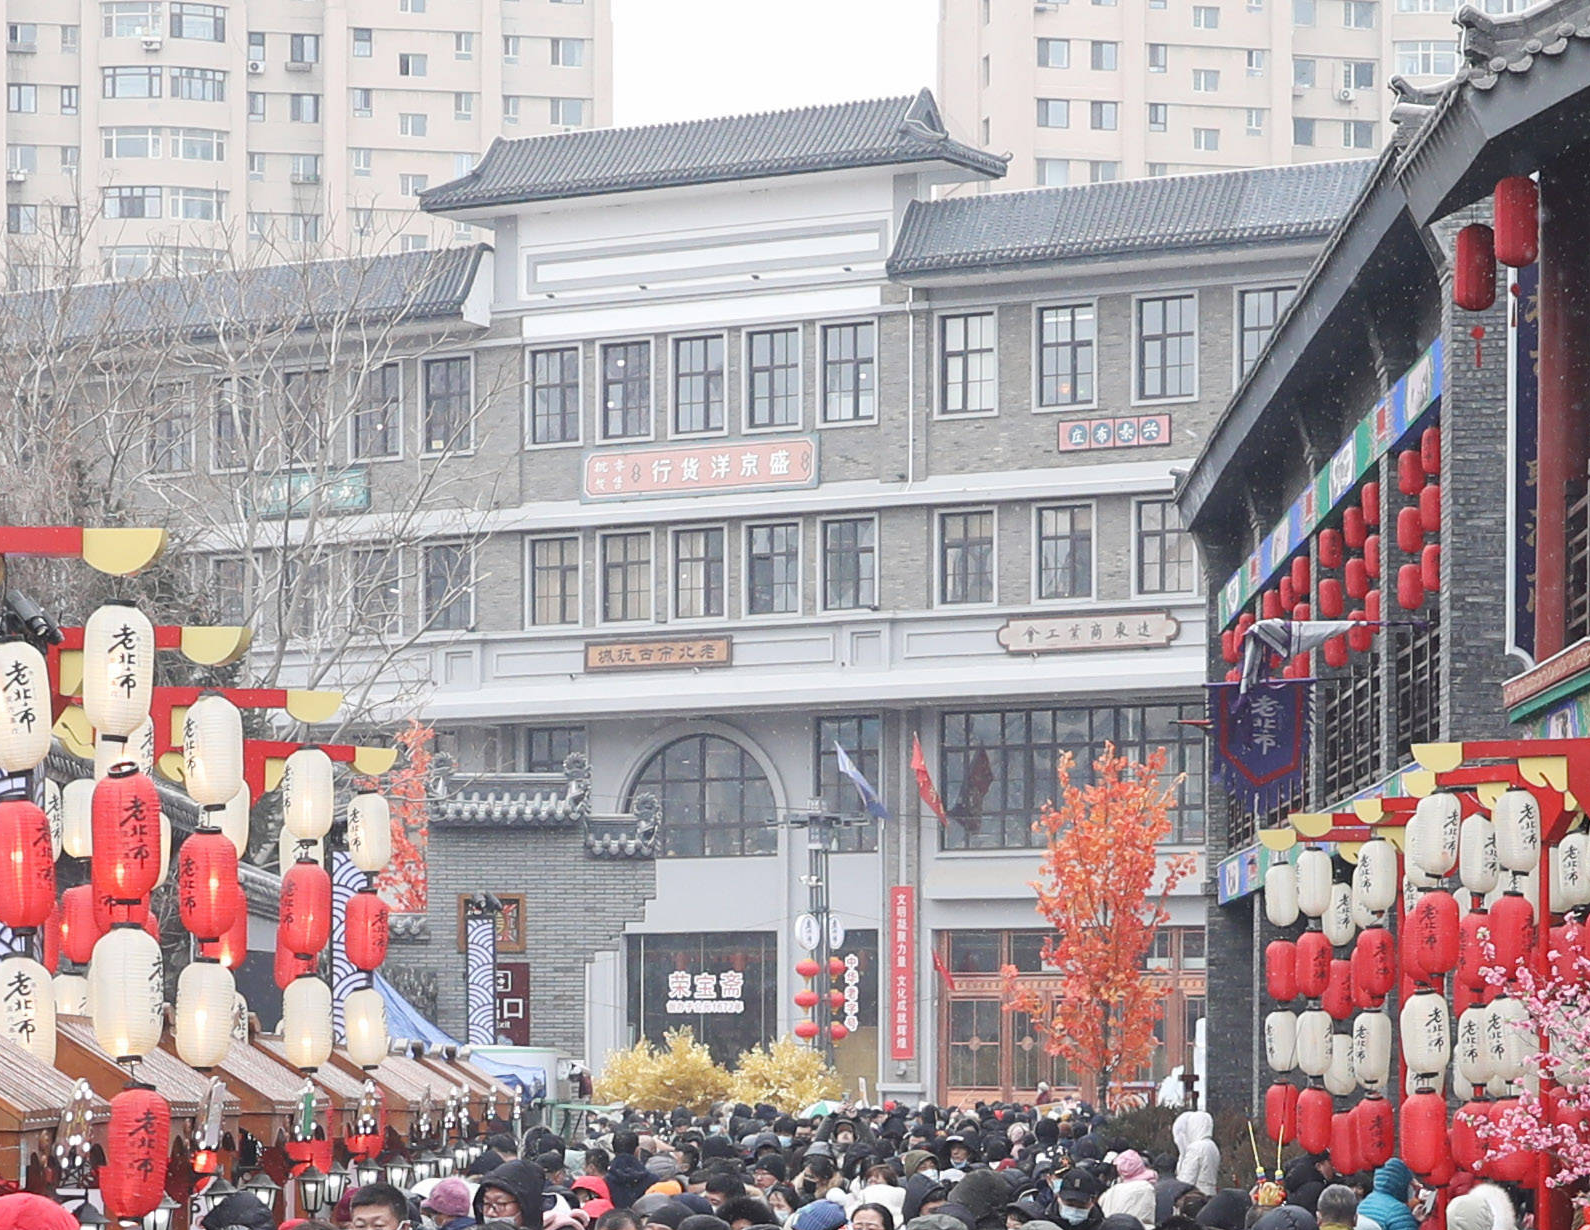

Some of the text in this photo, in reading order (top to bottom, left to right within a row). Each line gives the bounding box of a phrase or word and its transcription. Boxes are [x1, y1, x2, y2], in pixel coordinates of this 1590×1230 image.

[108, 624, 138, 699] 老北市
[597, 643, 717, 664] 老北市古玩城
[3, 659, 37, 734] 老北市
[182, 717, 199, 779] 老北市
[1251, 695, 1284, 756] 老北市
[120, 797, 151, 870] 老北市
[1442, 809, 1459, 859] 老北市
[1517, 802, 1539, 852] 老北市
[181, 856, 198, 918] 老北市
[1562, 844, 1580, 888] 老北市
[1337, 892, 1351, 930] 老北市
[1418, 904, 1439, 952] 老北市
[3, 970, 38, 1046] 老北市
[667, 969, 745, 999] 荣宝斋
[844, 954, 859, 1033] 中华老字号
[1424, 1006, 1445, 1054] 老北市
[1461, 1020, 1479, 1066] 老北市
[1487, 1012, 1506, 1061] 老北市
[129, 1109, 155, 1183] 老北市
